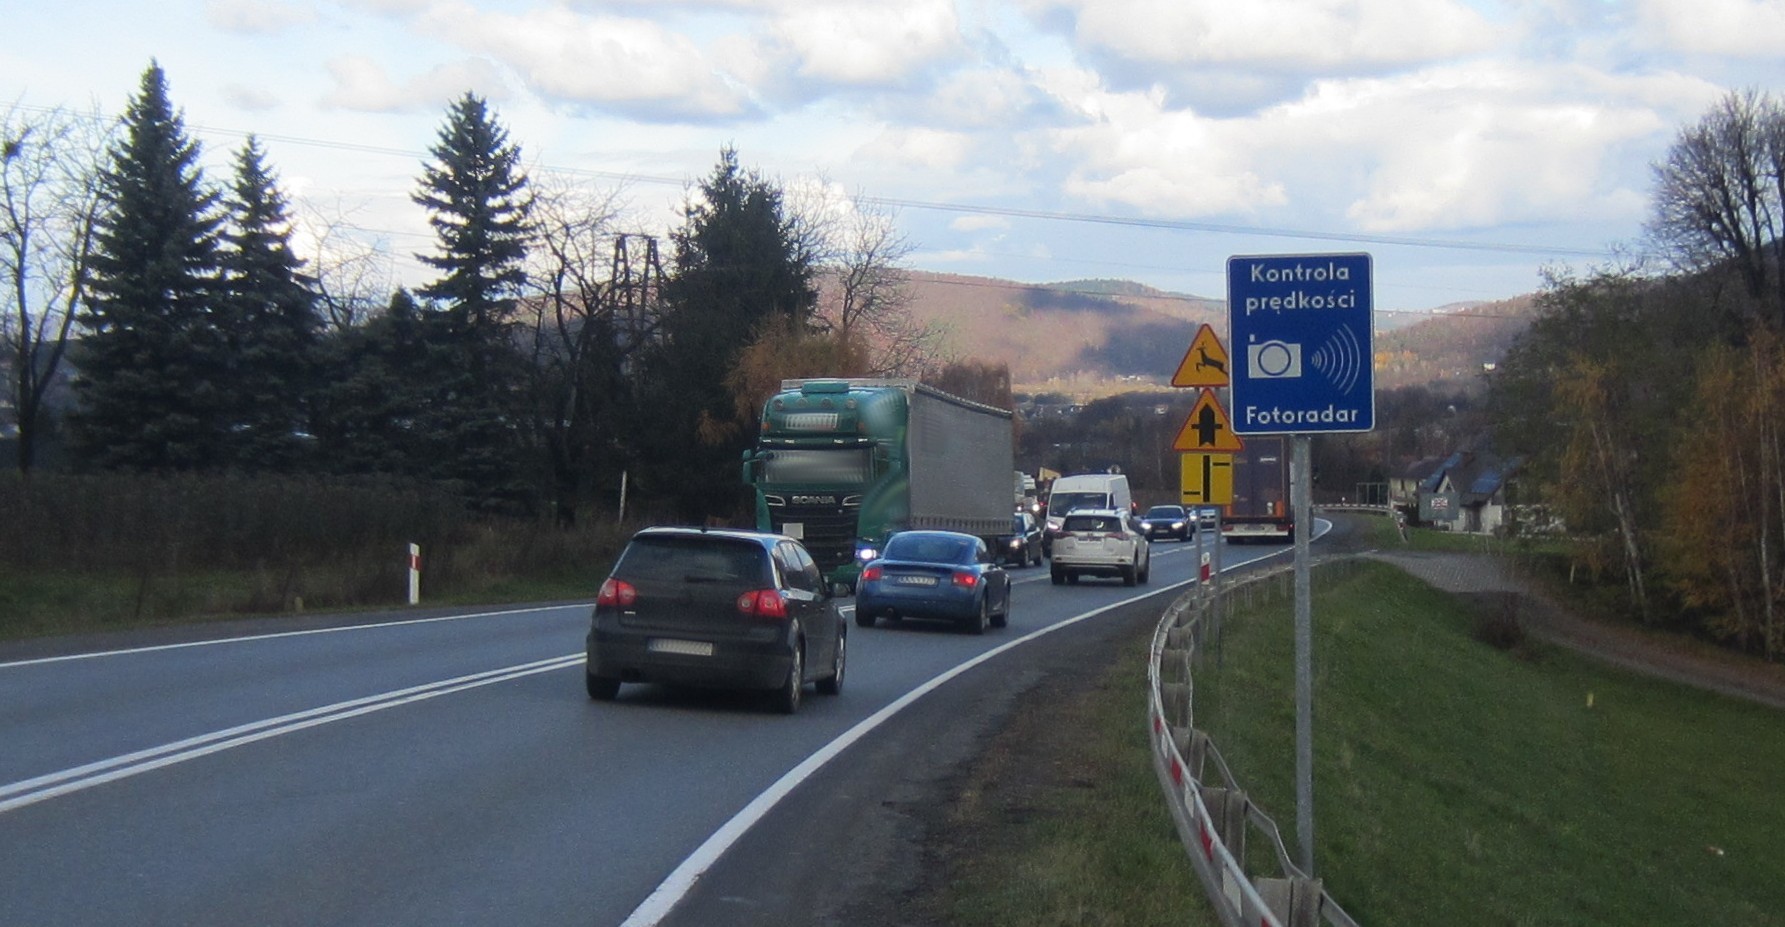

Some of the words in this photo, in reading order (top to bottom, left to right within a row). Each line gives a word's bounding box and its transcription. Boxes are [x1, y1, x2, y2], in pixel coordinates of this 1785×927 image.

[1251, 261, 1350, 282] Kontrola
[1246, 289, 1355, 316] prędkości
[1246, 404, 1358, 424] Fotoradar
[791, 495, 836, 505] SCANIA
